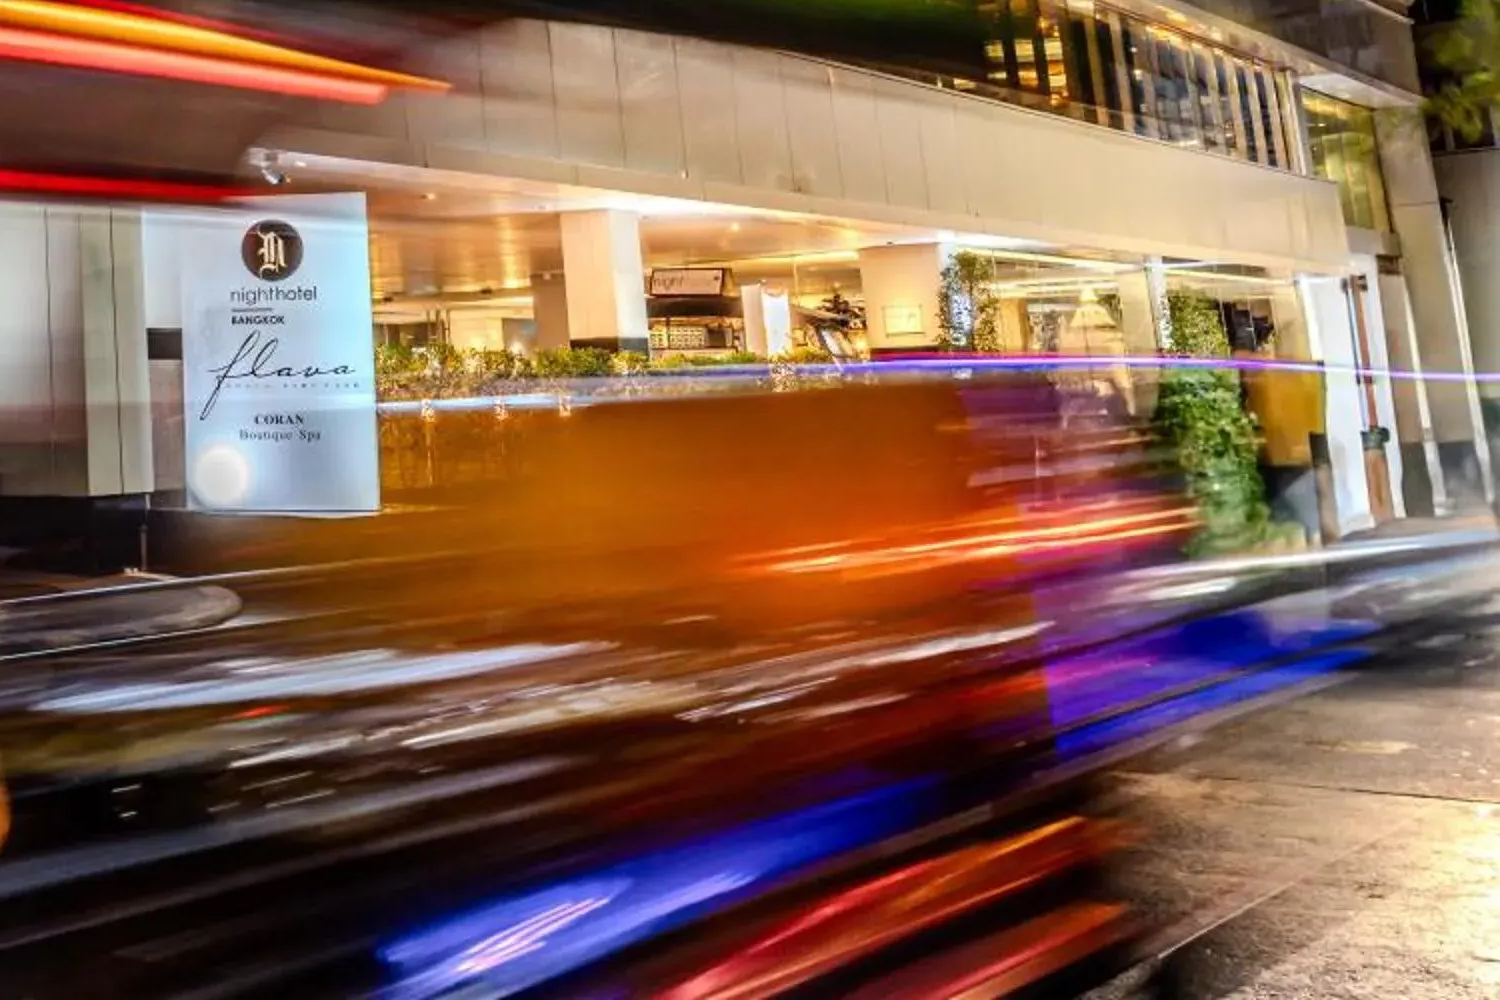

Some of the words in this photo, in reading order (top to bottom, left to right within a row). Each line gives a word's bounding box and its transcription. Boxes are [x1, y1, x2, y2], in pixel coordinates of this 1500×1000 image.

[230, 285, 317, 306] nighthotel
[231, 315, 284, 325] BANGKOK
[200, 329, 357, 420] flava
[254, 412, 304, 425] CORAN
[239, 429, 293, 442] Boutique
[298, 429, 321, 443] Spa
